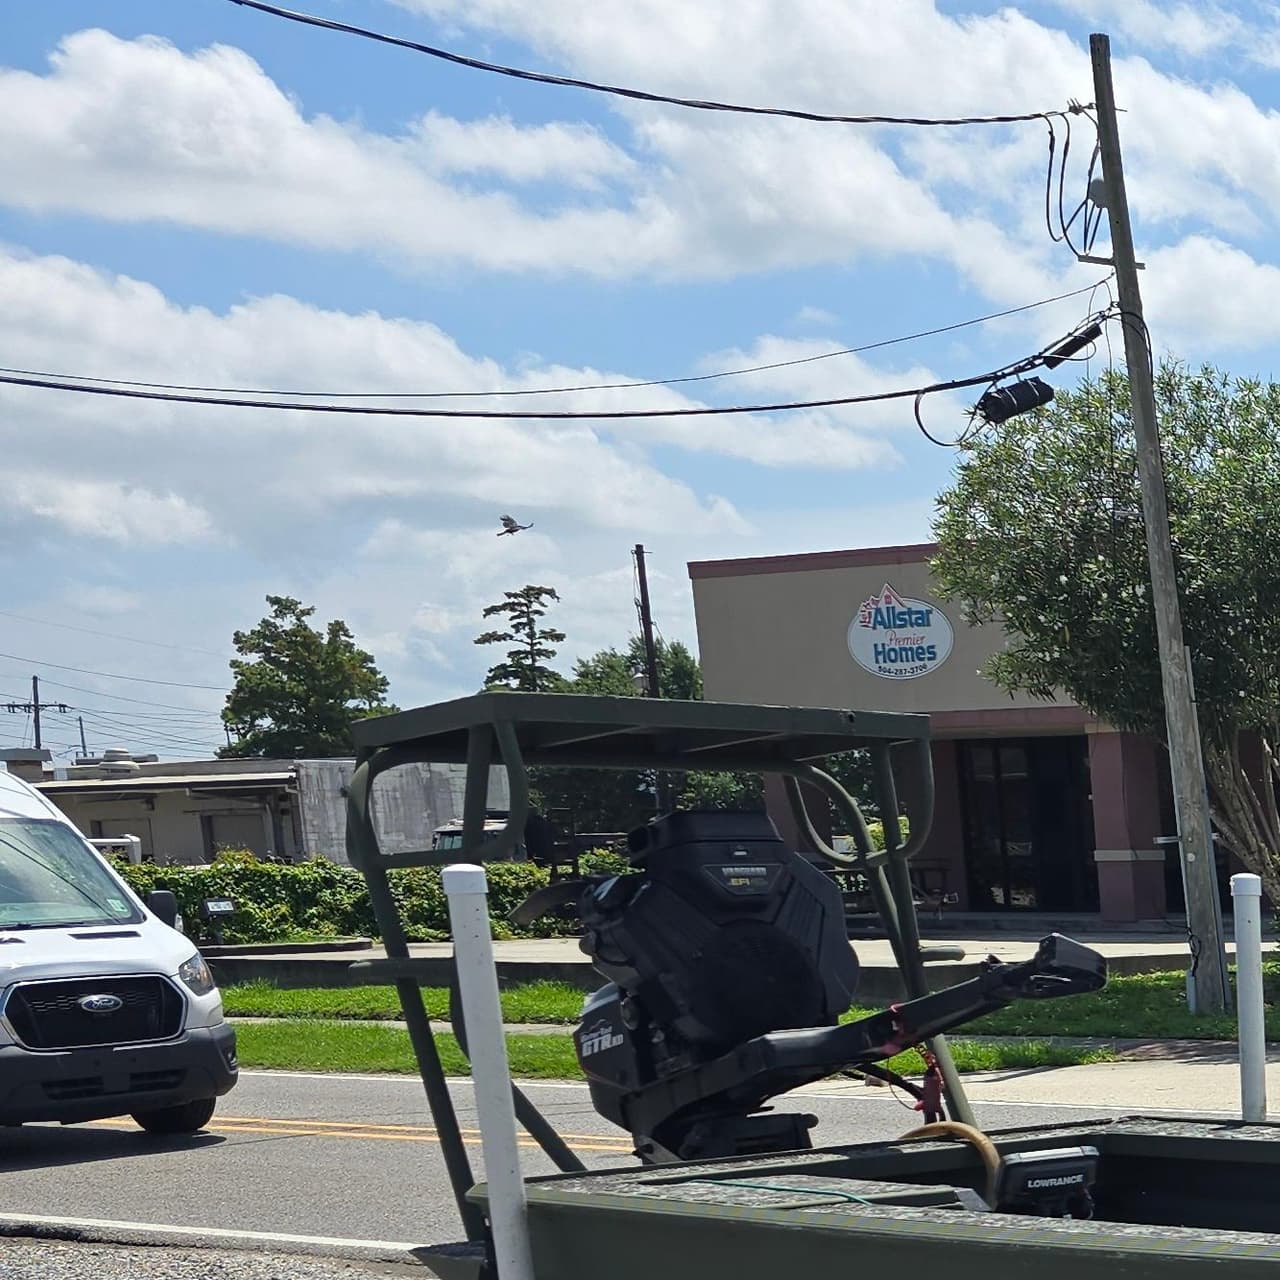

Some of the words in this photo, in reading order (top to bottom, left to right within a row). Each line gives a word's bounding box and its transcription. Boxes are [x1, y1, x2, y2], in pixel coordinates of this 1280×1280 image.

[872, 606, 933, 629] Allstar
[885, 630, 926, 646] Premier
[873, 643, 937, 664] Homes
[1027, 1174, 1084, 1188] LOWRANCE
